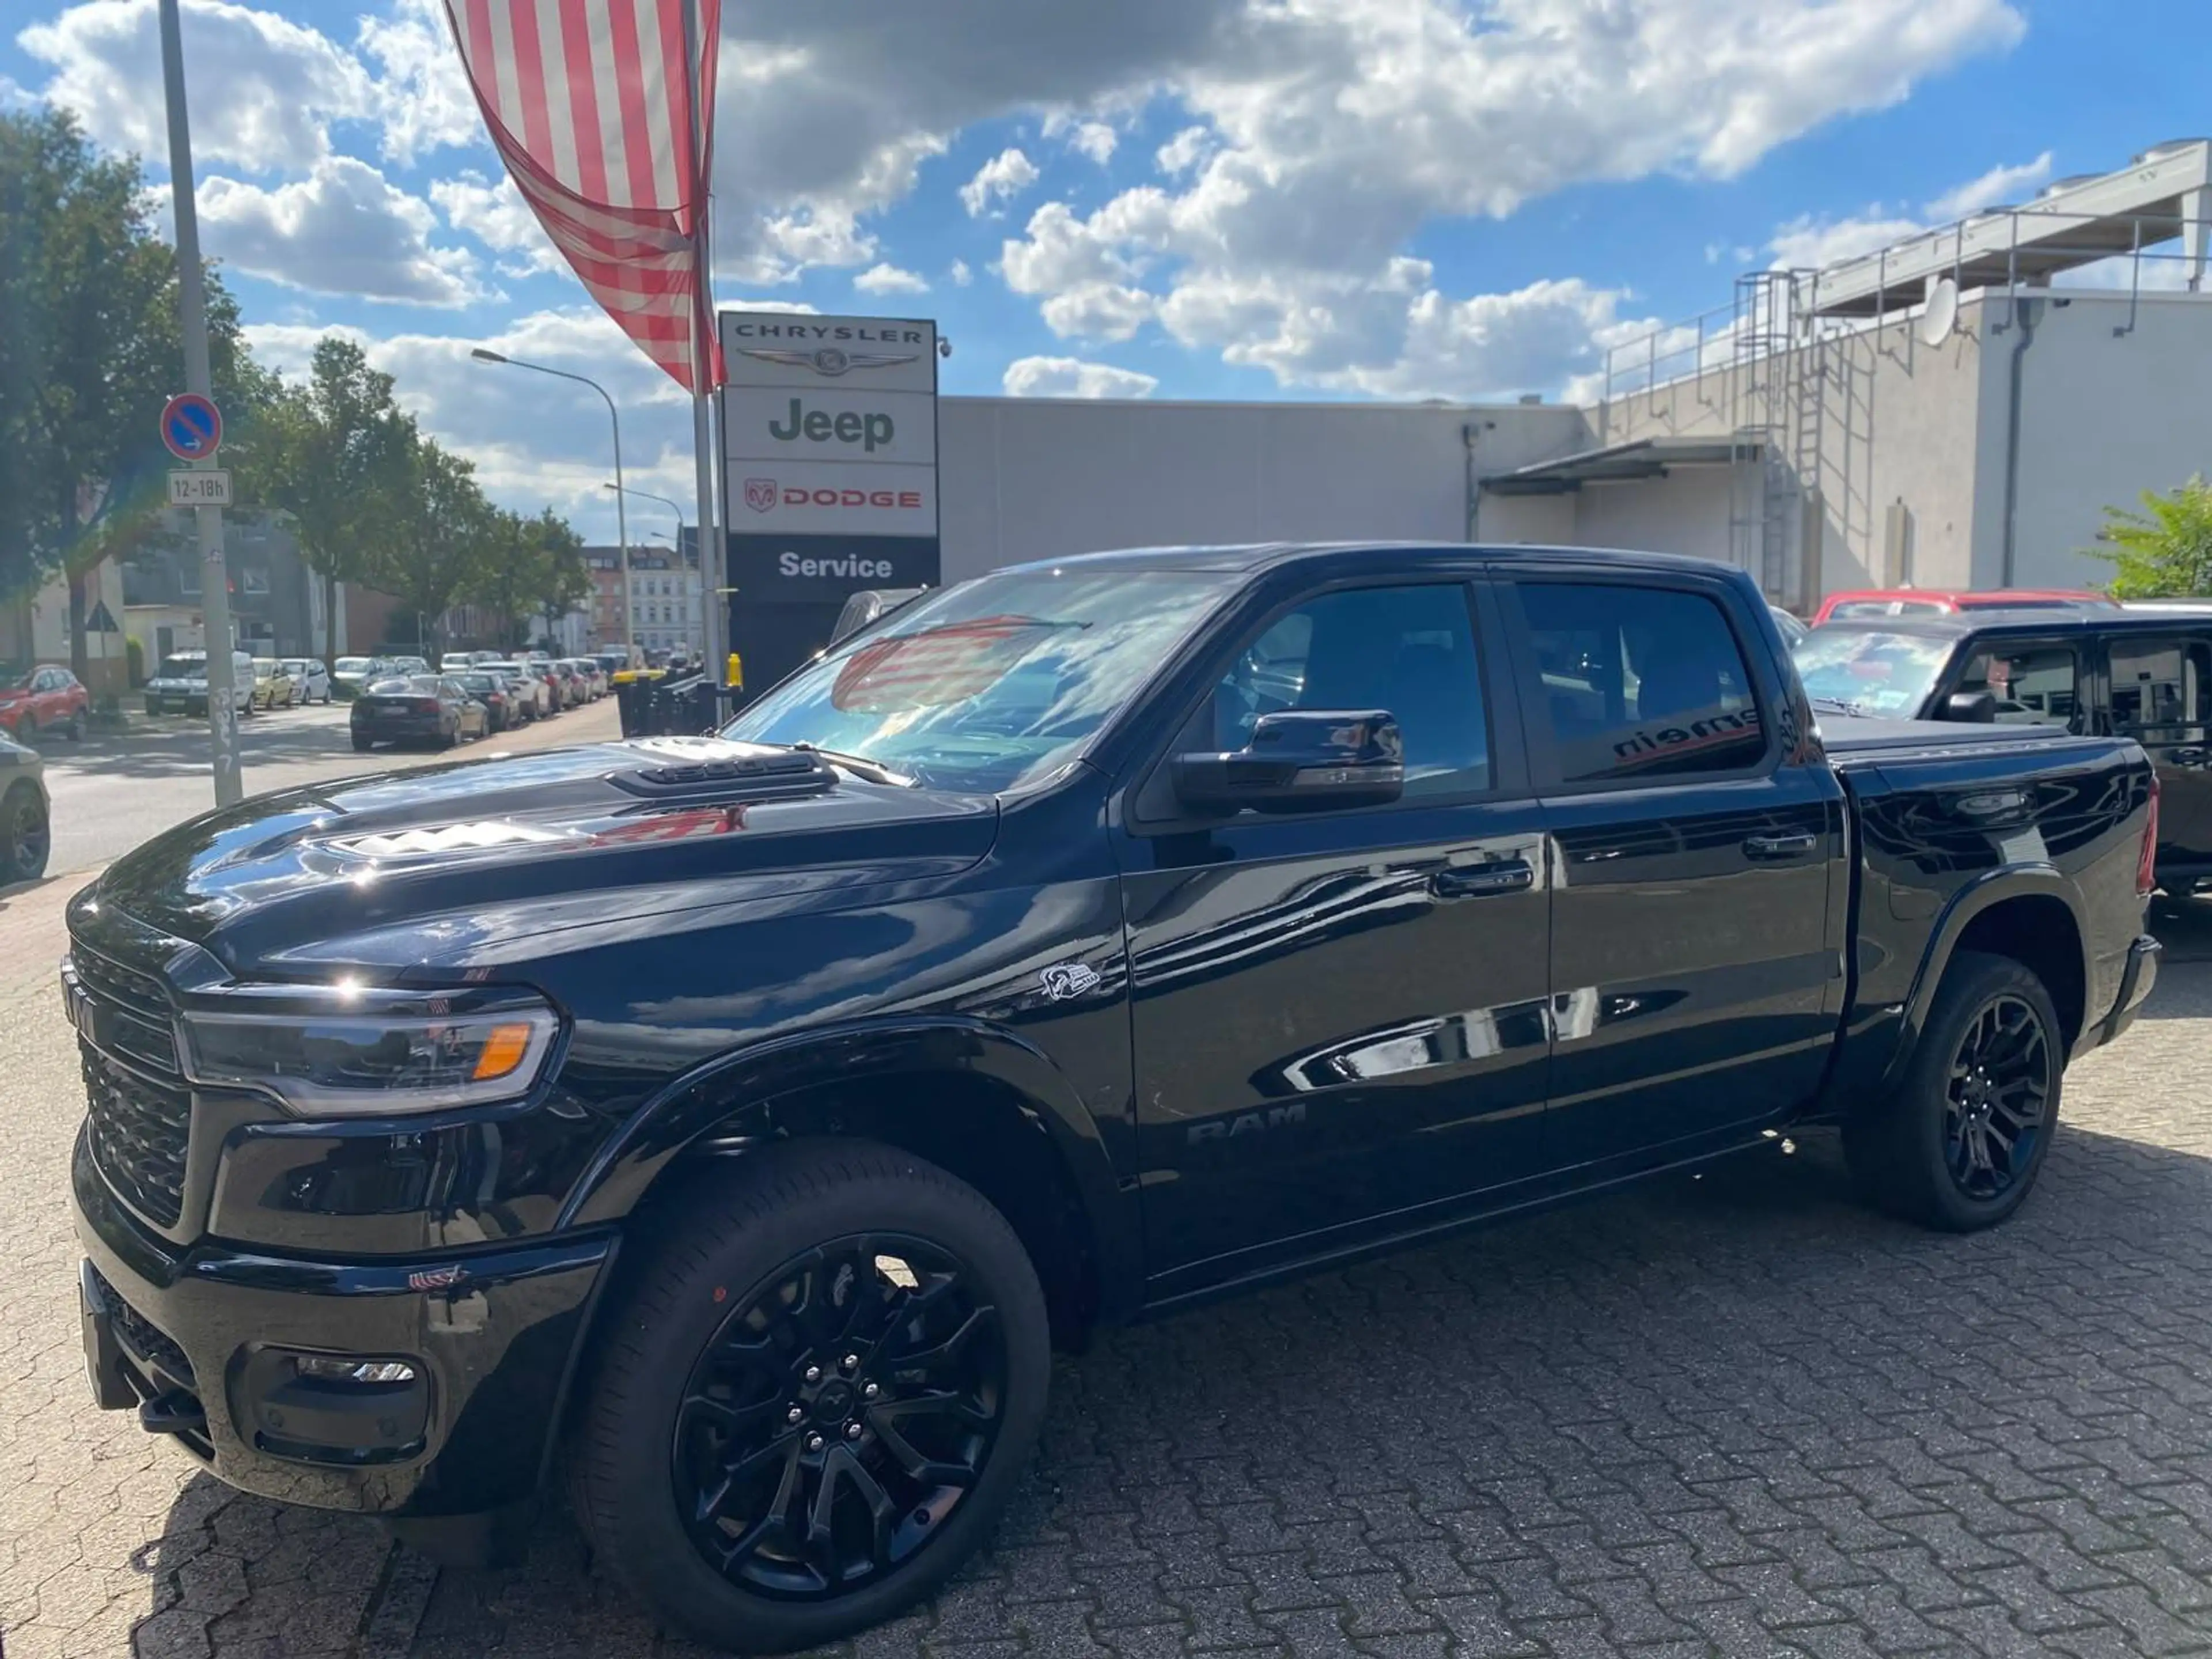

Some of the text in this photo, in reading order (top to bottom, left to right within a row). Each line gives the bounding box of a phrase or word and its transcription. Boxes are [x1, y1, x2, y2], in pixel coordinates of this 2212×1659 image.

[735, 324, 922, 343] CHRYSLER
[768, 398, 895, 452] Jeep
[175, 479, 224, 497] 12-18h
[783, 488, 922, 508] DODGE
[779, 551, 893, 578] Service
[1187, 1103, 1306, 1145] RAM
